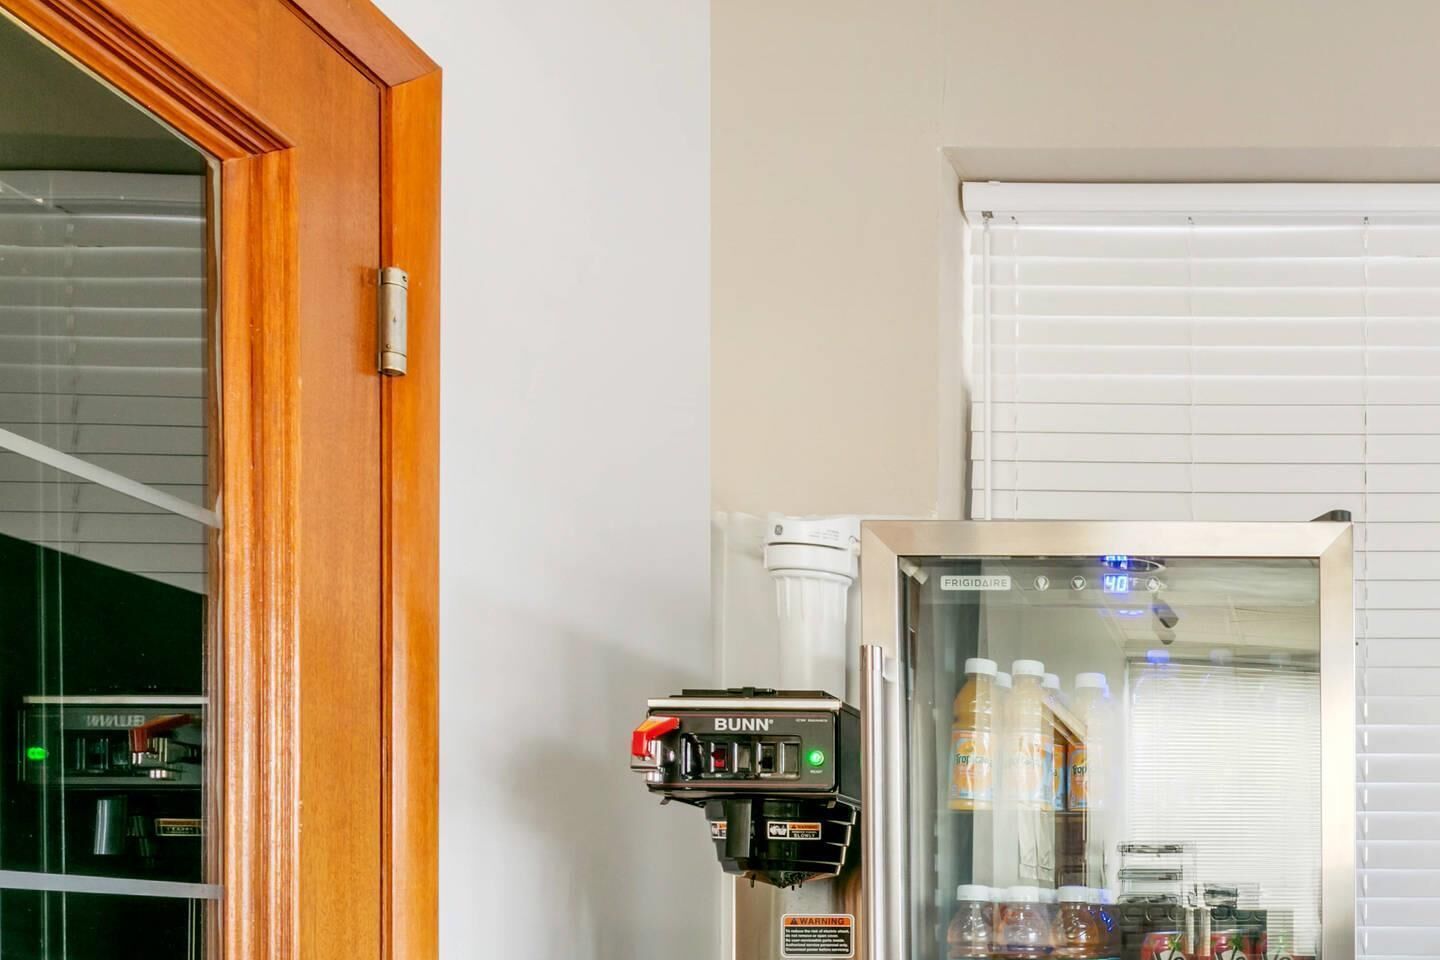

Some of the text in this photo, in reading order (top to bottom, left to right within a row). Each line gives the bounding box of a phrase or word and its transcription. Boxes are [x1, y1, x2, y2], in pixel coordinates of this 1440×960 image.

[944, 578, 1008, 587] FRIGIDAIRE
[1105, 575, 1127, 591] 40
[714, 718, 769, 731] BUNN
